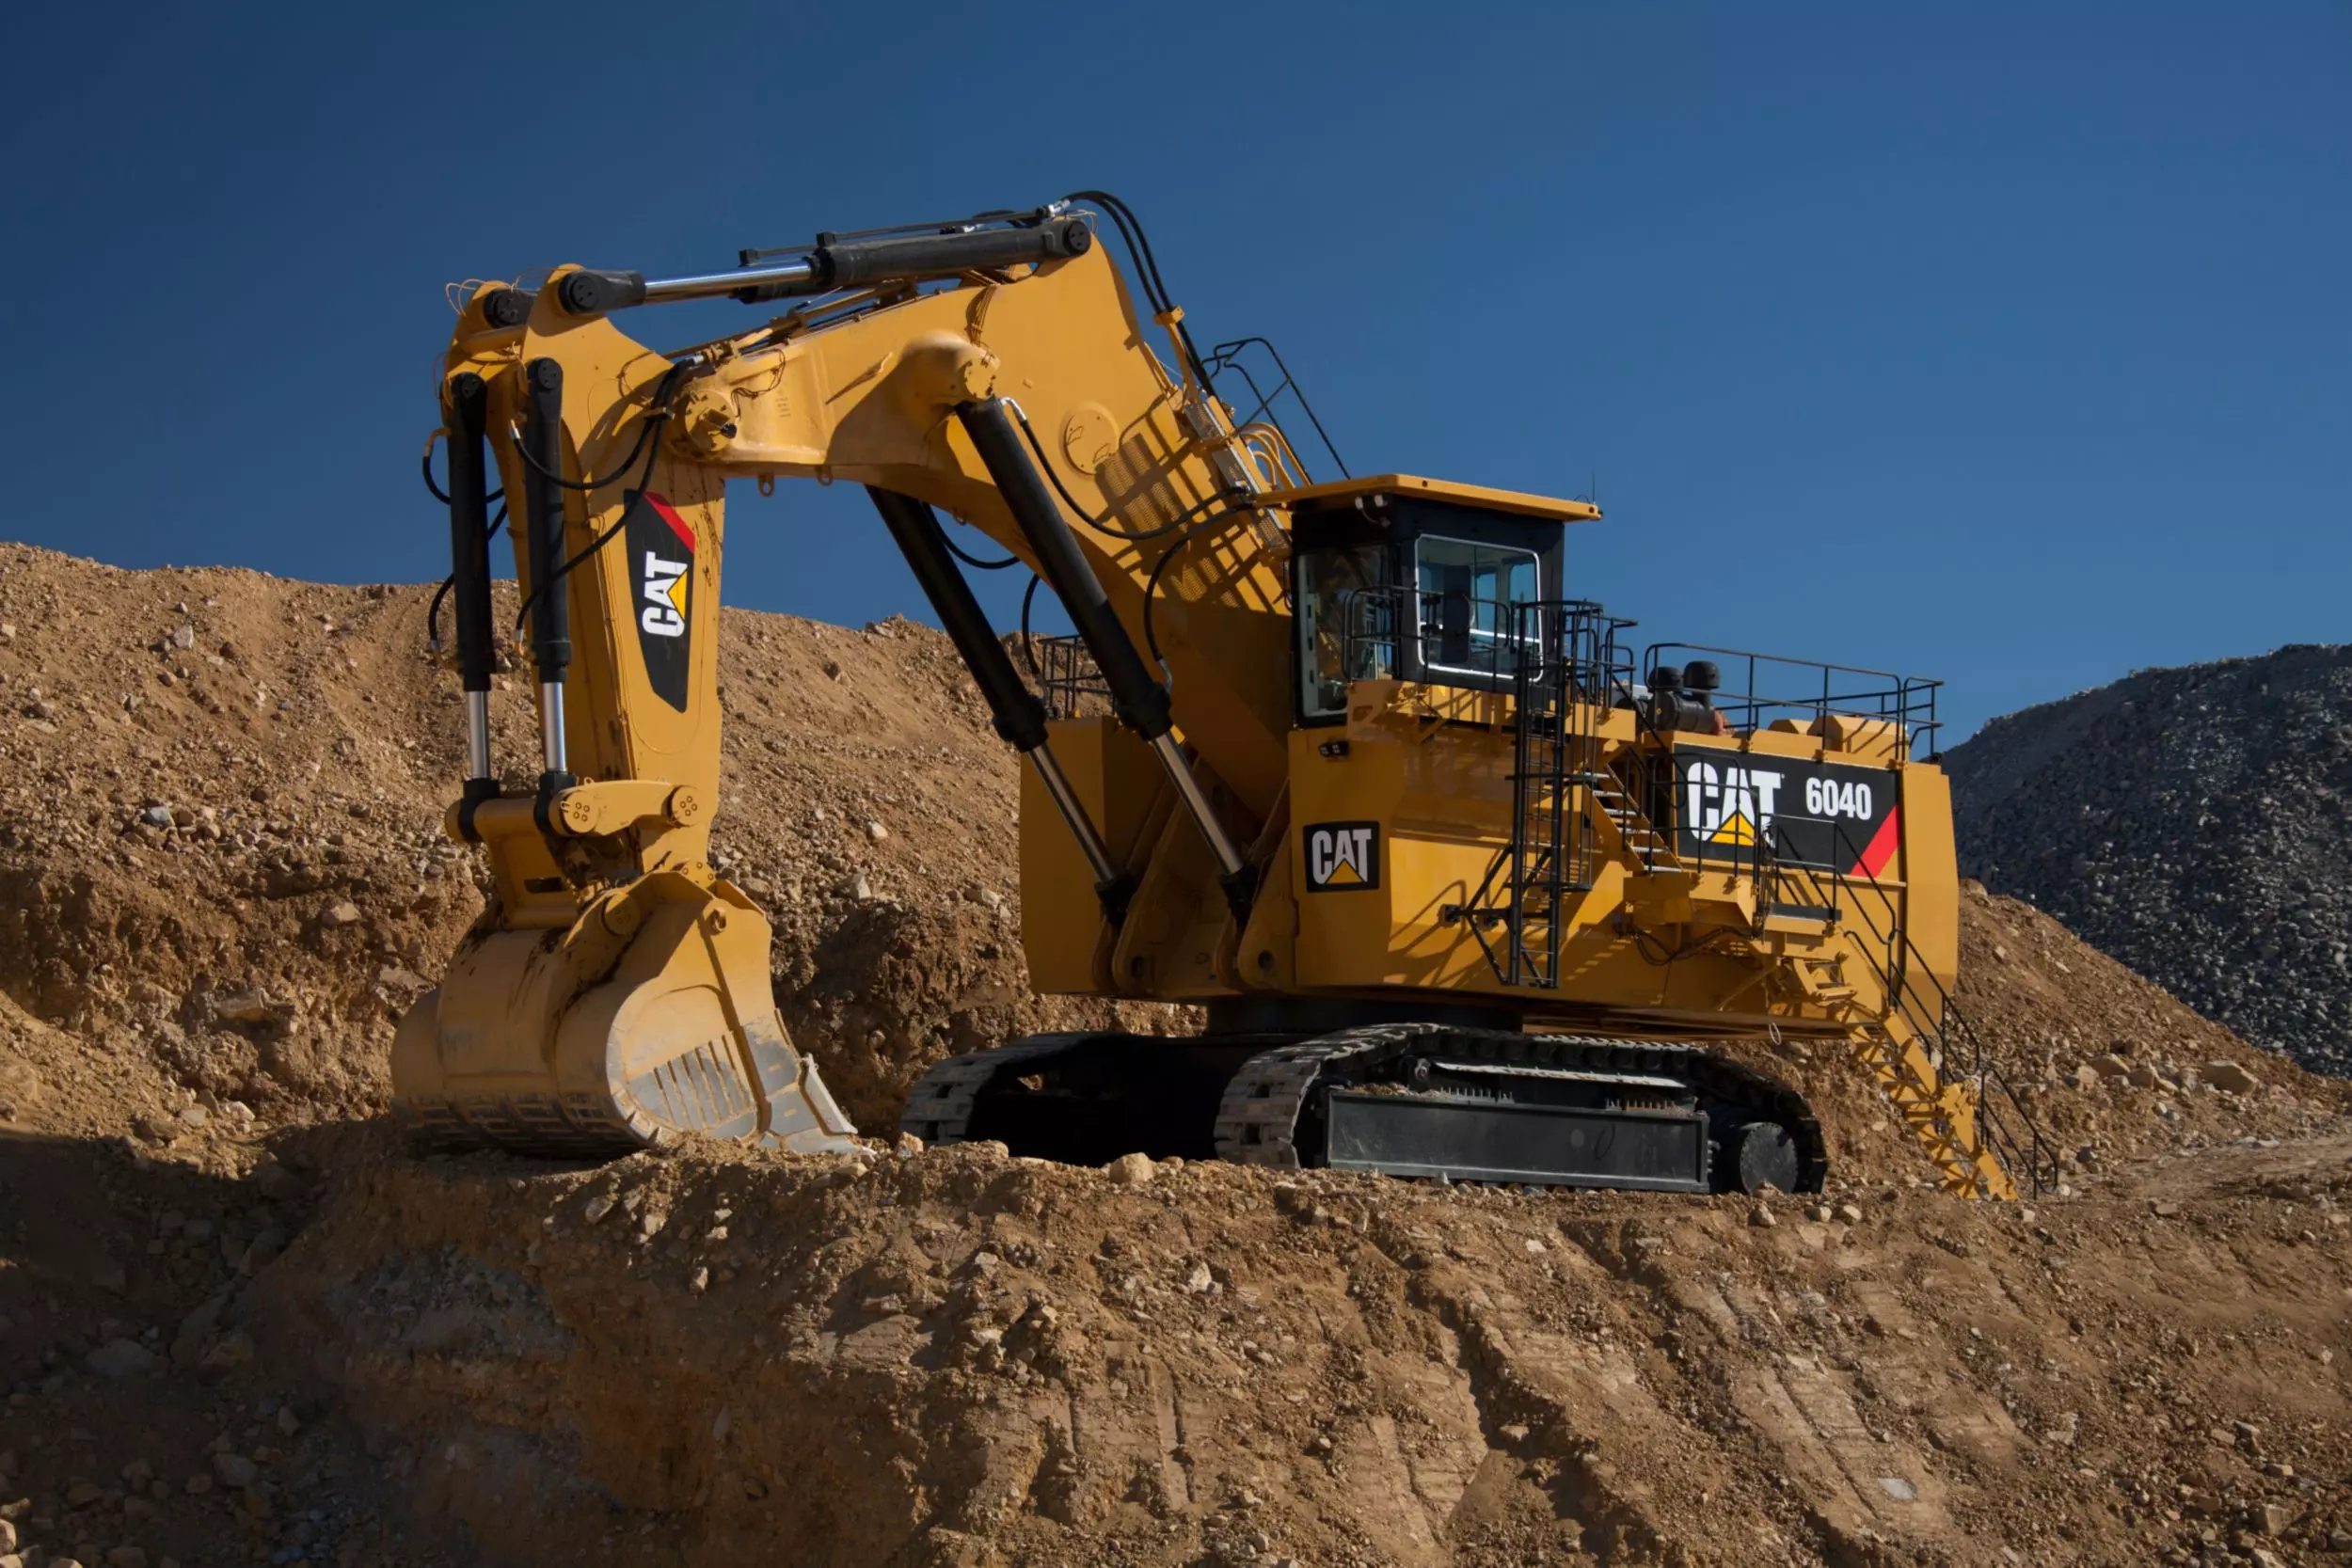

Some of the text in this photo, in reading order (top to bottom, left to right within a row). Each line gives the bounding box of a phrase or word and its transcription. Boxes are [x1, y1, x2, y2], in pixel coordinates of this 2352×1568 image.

[642, 550, 688, 638] CAT
[1687, 762, 1872, 848] CAT 6040
[1311, 829, 1372, 884] CAT
